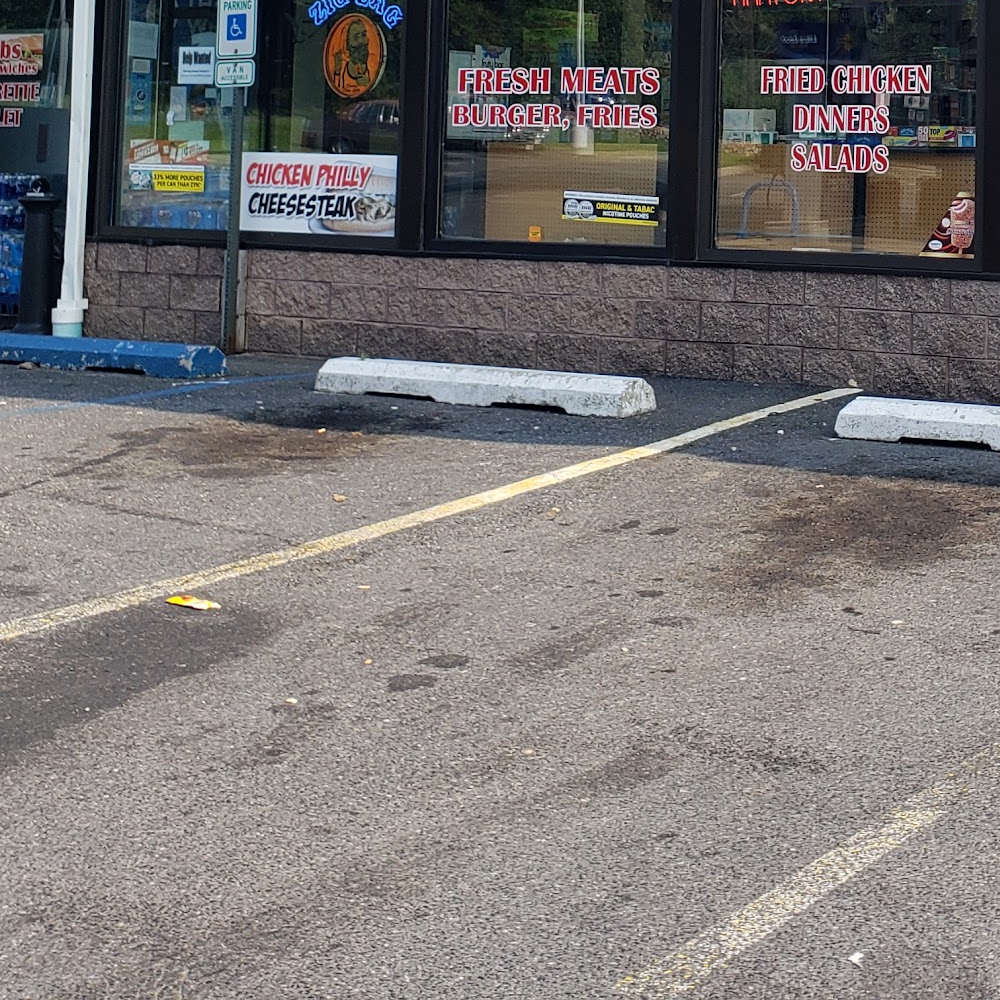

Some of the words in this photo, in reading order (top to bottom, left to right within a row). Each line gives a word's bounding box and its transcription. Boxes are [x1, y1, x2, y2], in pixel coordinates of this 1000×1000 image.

[223, 0, 252, 11] PARKING
[457, 67, 552, 95] FRESH
[560, 66, 660, 96] MEATS
[760, 66, 826, 95] FRIED
[831, 64, 932, 95] CHICKEN
[452, 104, 570, 132] BURGER,
[577, 104, 658, 129] FRIES
[793, 105, 890, 134] DINNERS
[790, 143, 890, 174] SALADS
[180, 174, 203, 182] POUCHES
[246, 163, 311, 187] CHICKEN
[315, 164, 372, 190] PHILLY
[247, 193, 358, 219] CHEESESTEAK
[596, 202, 626, 212] ORIGINAL
[633, 205, 655, 213] TABAC
[626, 211, 649, 219] POUCHES
